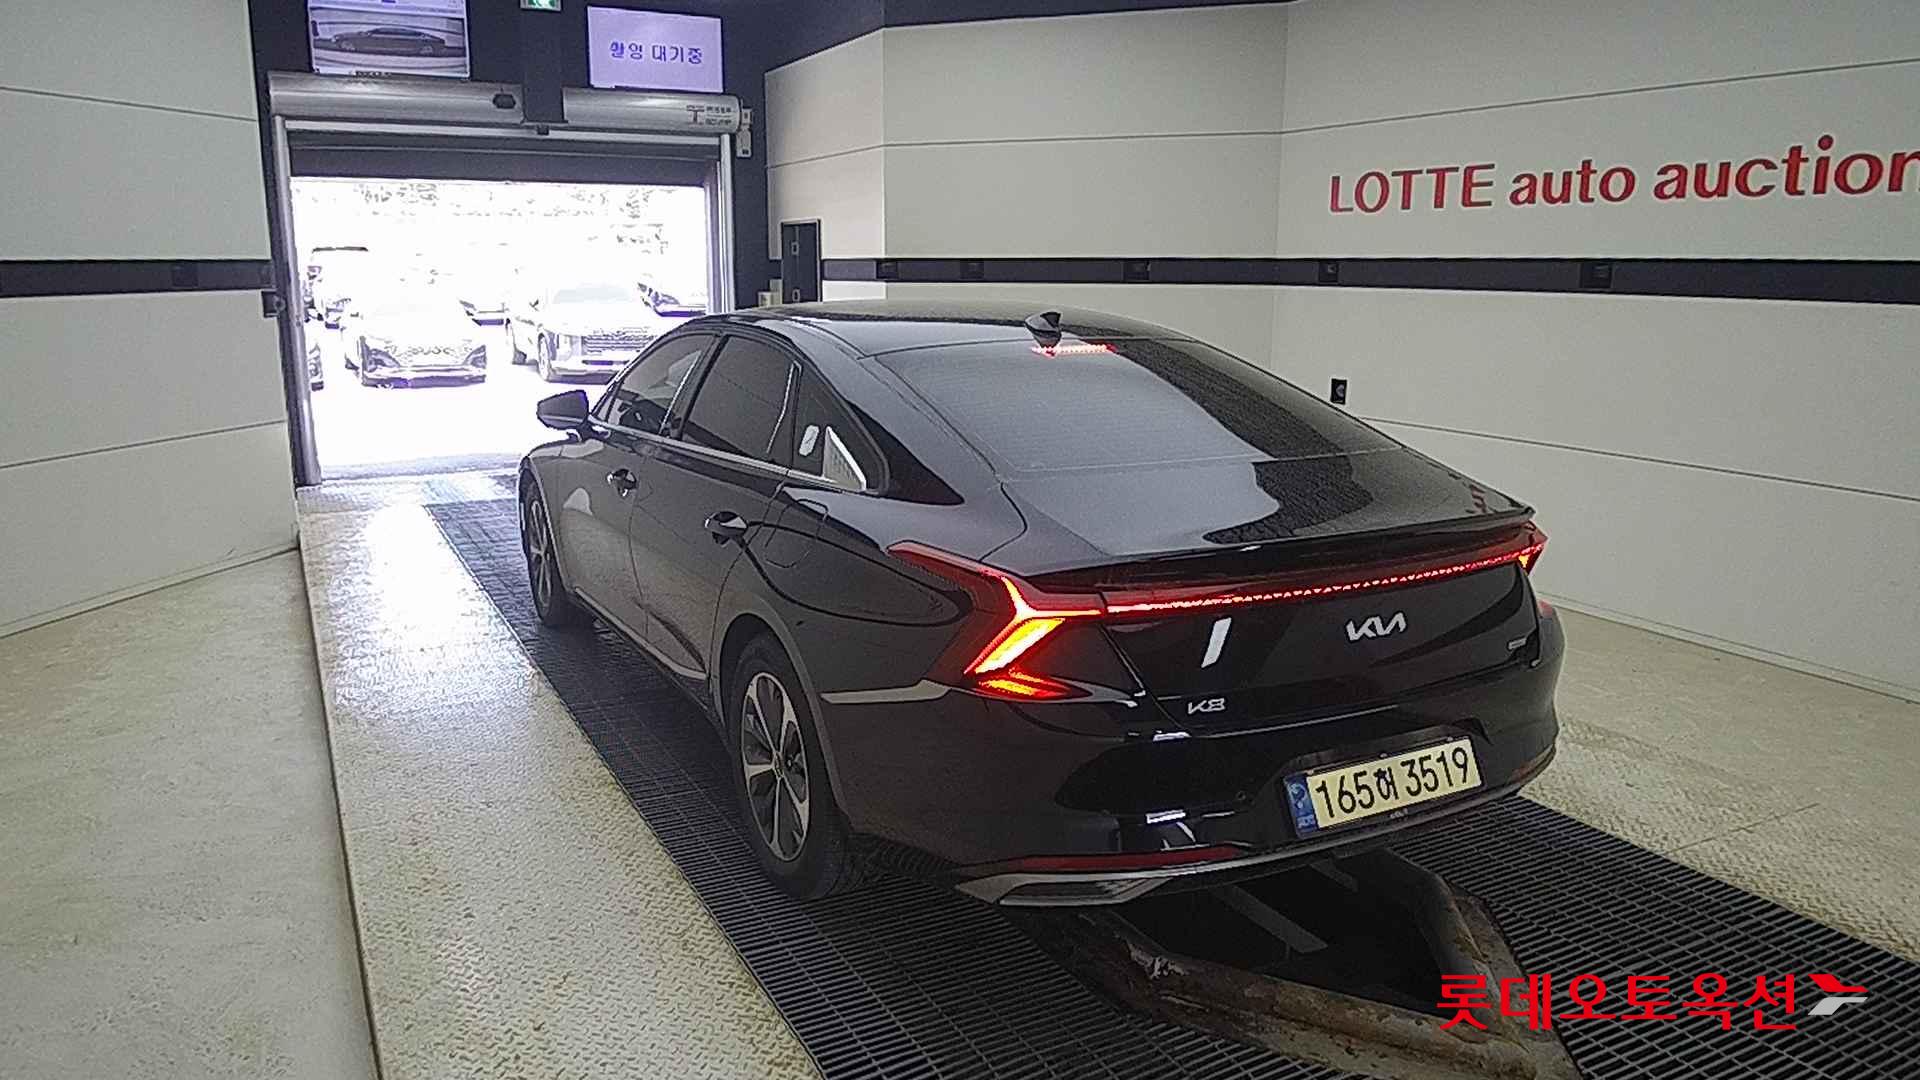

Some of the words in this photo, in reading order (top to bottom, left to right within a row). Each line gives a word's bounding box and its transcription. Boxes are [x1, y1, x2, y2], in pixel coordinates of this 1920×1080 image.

[1330, 165, 1496, 212] LOTTE
[1511, 158, 1637, 205] auto
[1345, 611, 1408, 642] KIA
[1188, 697, 1226, 715] K8
[1400, 746, 1469, 797] 3519
